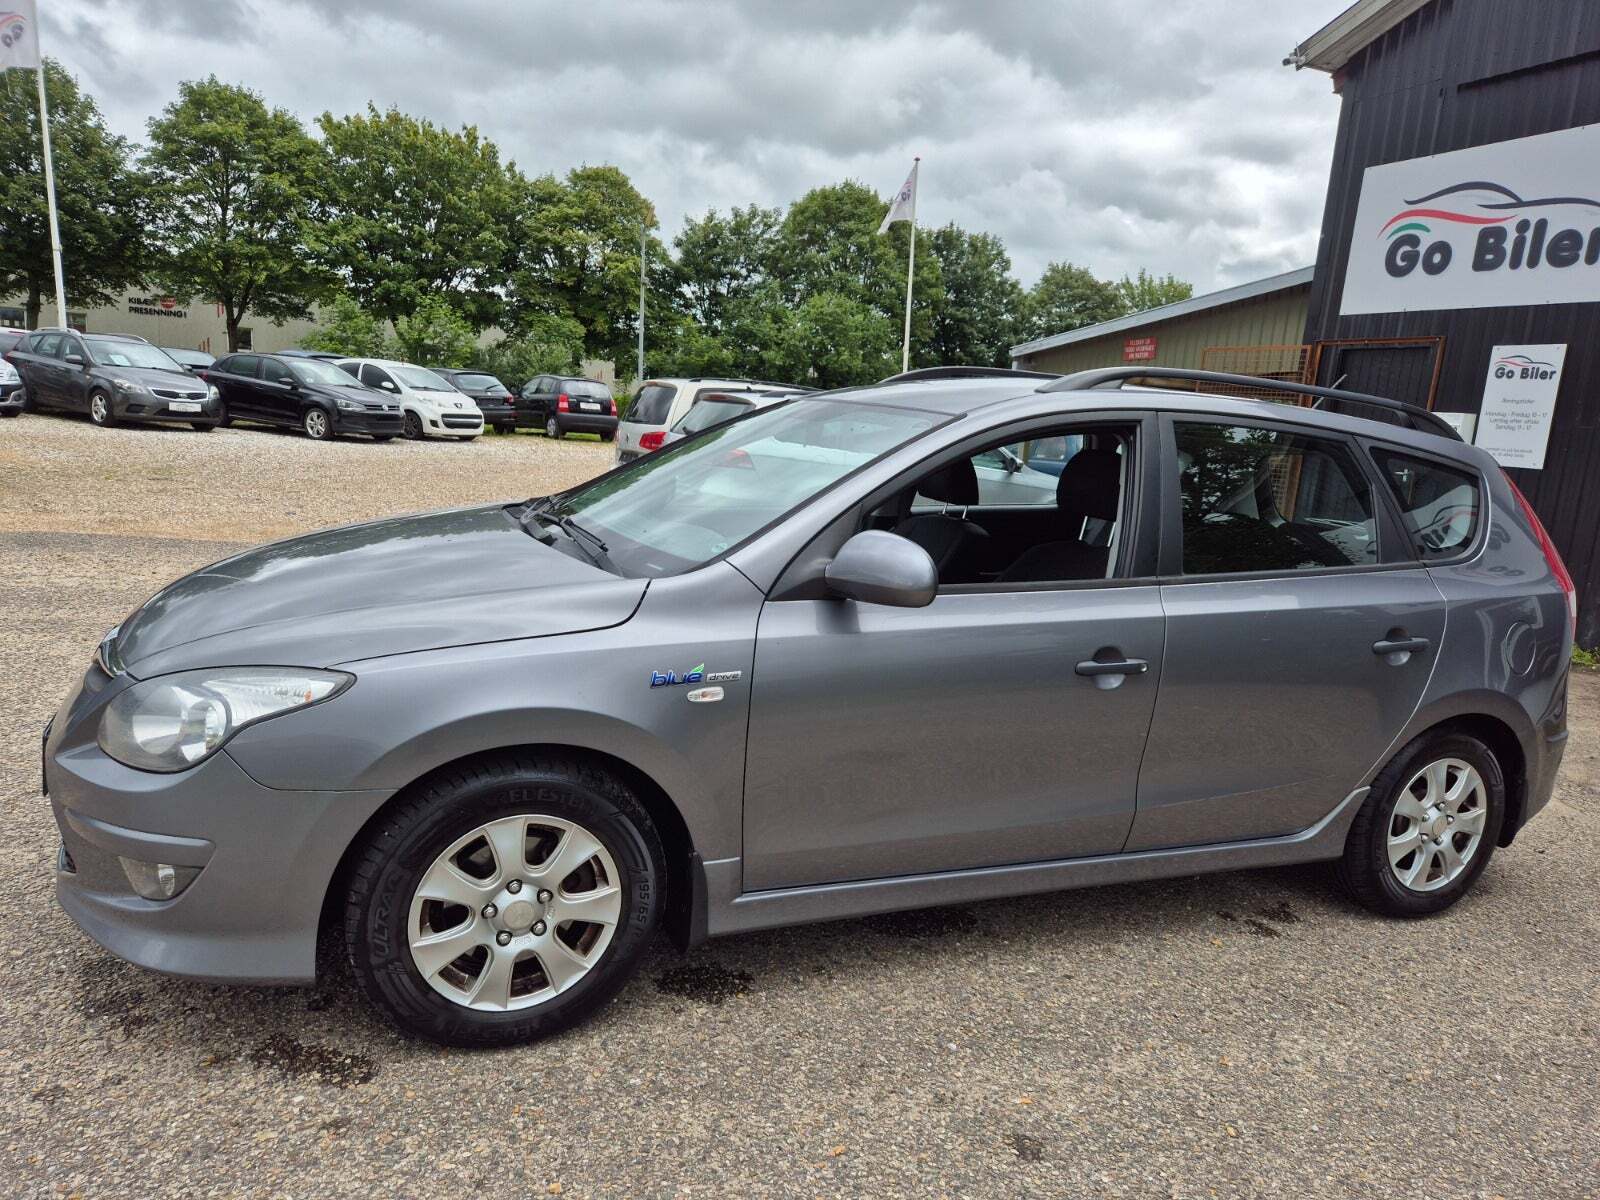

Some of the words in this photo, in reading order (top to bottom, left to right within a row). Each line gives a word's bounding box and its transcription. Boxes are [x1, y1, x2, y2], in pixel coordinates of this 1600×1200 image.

[1385, 234, 1453, 278] Go
[1472, 218, 1600, 272] Biler
[1494, 367, 1515, 379] Go
[1520, 367, 1557, 380] Biler
[650, 669, 704, 688] blue
